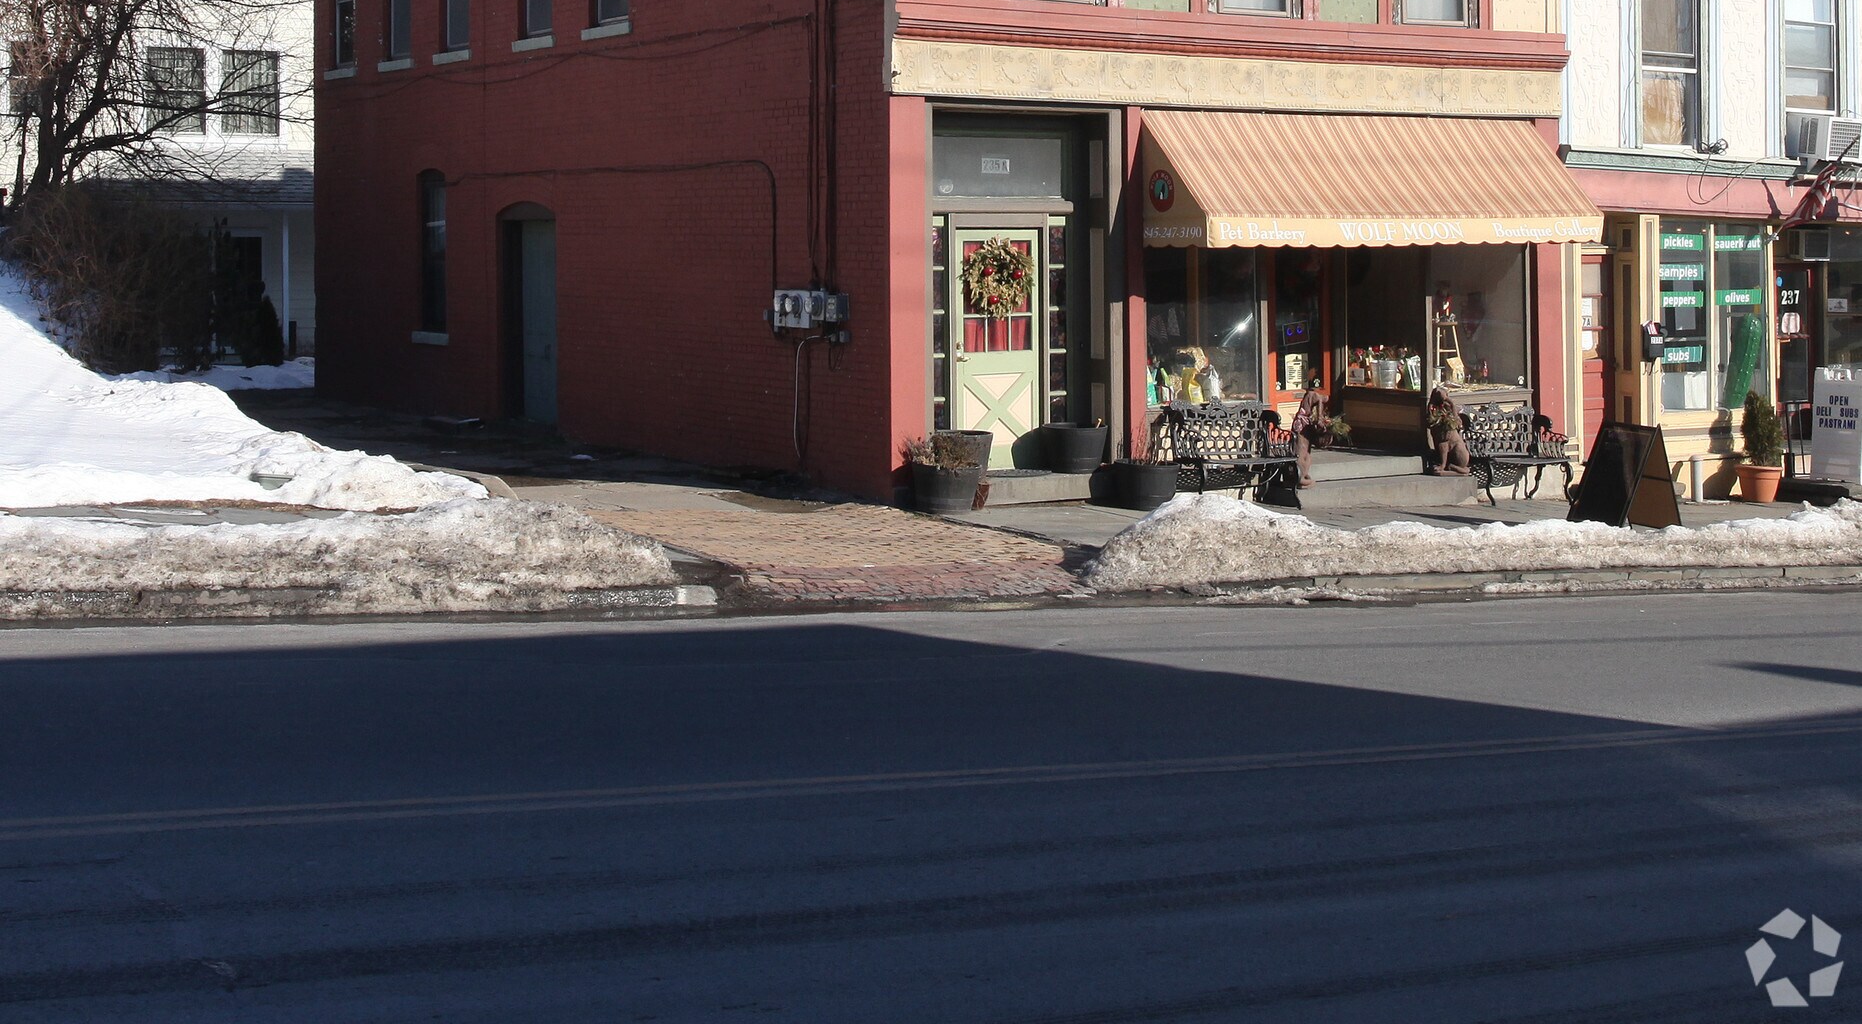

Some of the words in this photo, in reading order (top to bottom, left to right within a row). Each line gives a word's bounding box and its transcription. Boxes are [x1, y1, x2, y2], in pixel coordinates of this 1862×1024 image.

[1219, 222, 1243, 240] Pet
[1247, 220, 1305, 244] Barkery
[1338, 222, 1398, 241] WOLF
[1400, 221, 1465, 240] MOON
[1492, 222, 1553, 241] Boutique
[1554, 219, 1600, 240] Gallery
[1663, 236, 1694, 249] pickles
[1659, 266, 1698, 279] samples
[1663, 295, 1696, 307] peppers
[1725, 292, 1750, 303] olives
[1781, 290, 1800, 305] 237
[1667, 350, 1690, 362] subs
[1829, 395, 1849, 406] OPEN
[1816, 406, 1832, 417] DELI
[1840, 407, 1859, 419] SUBS
[1819, 418, 1856, 430] PASTRAMI
